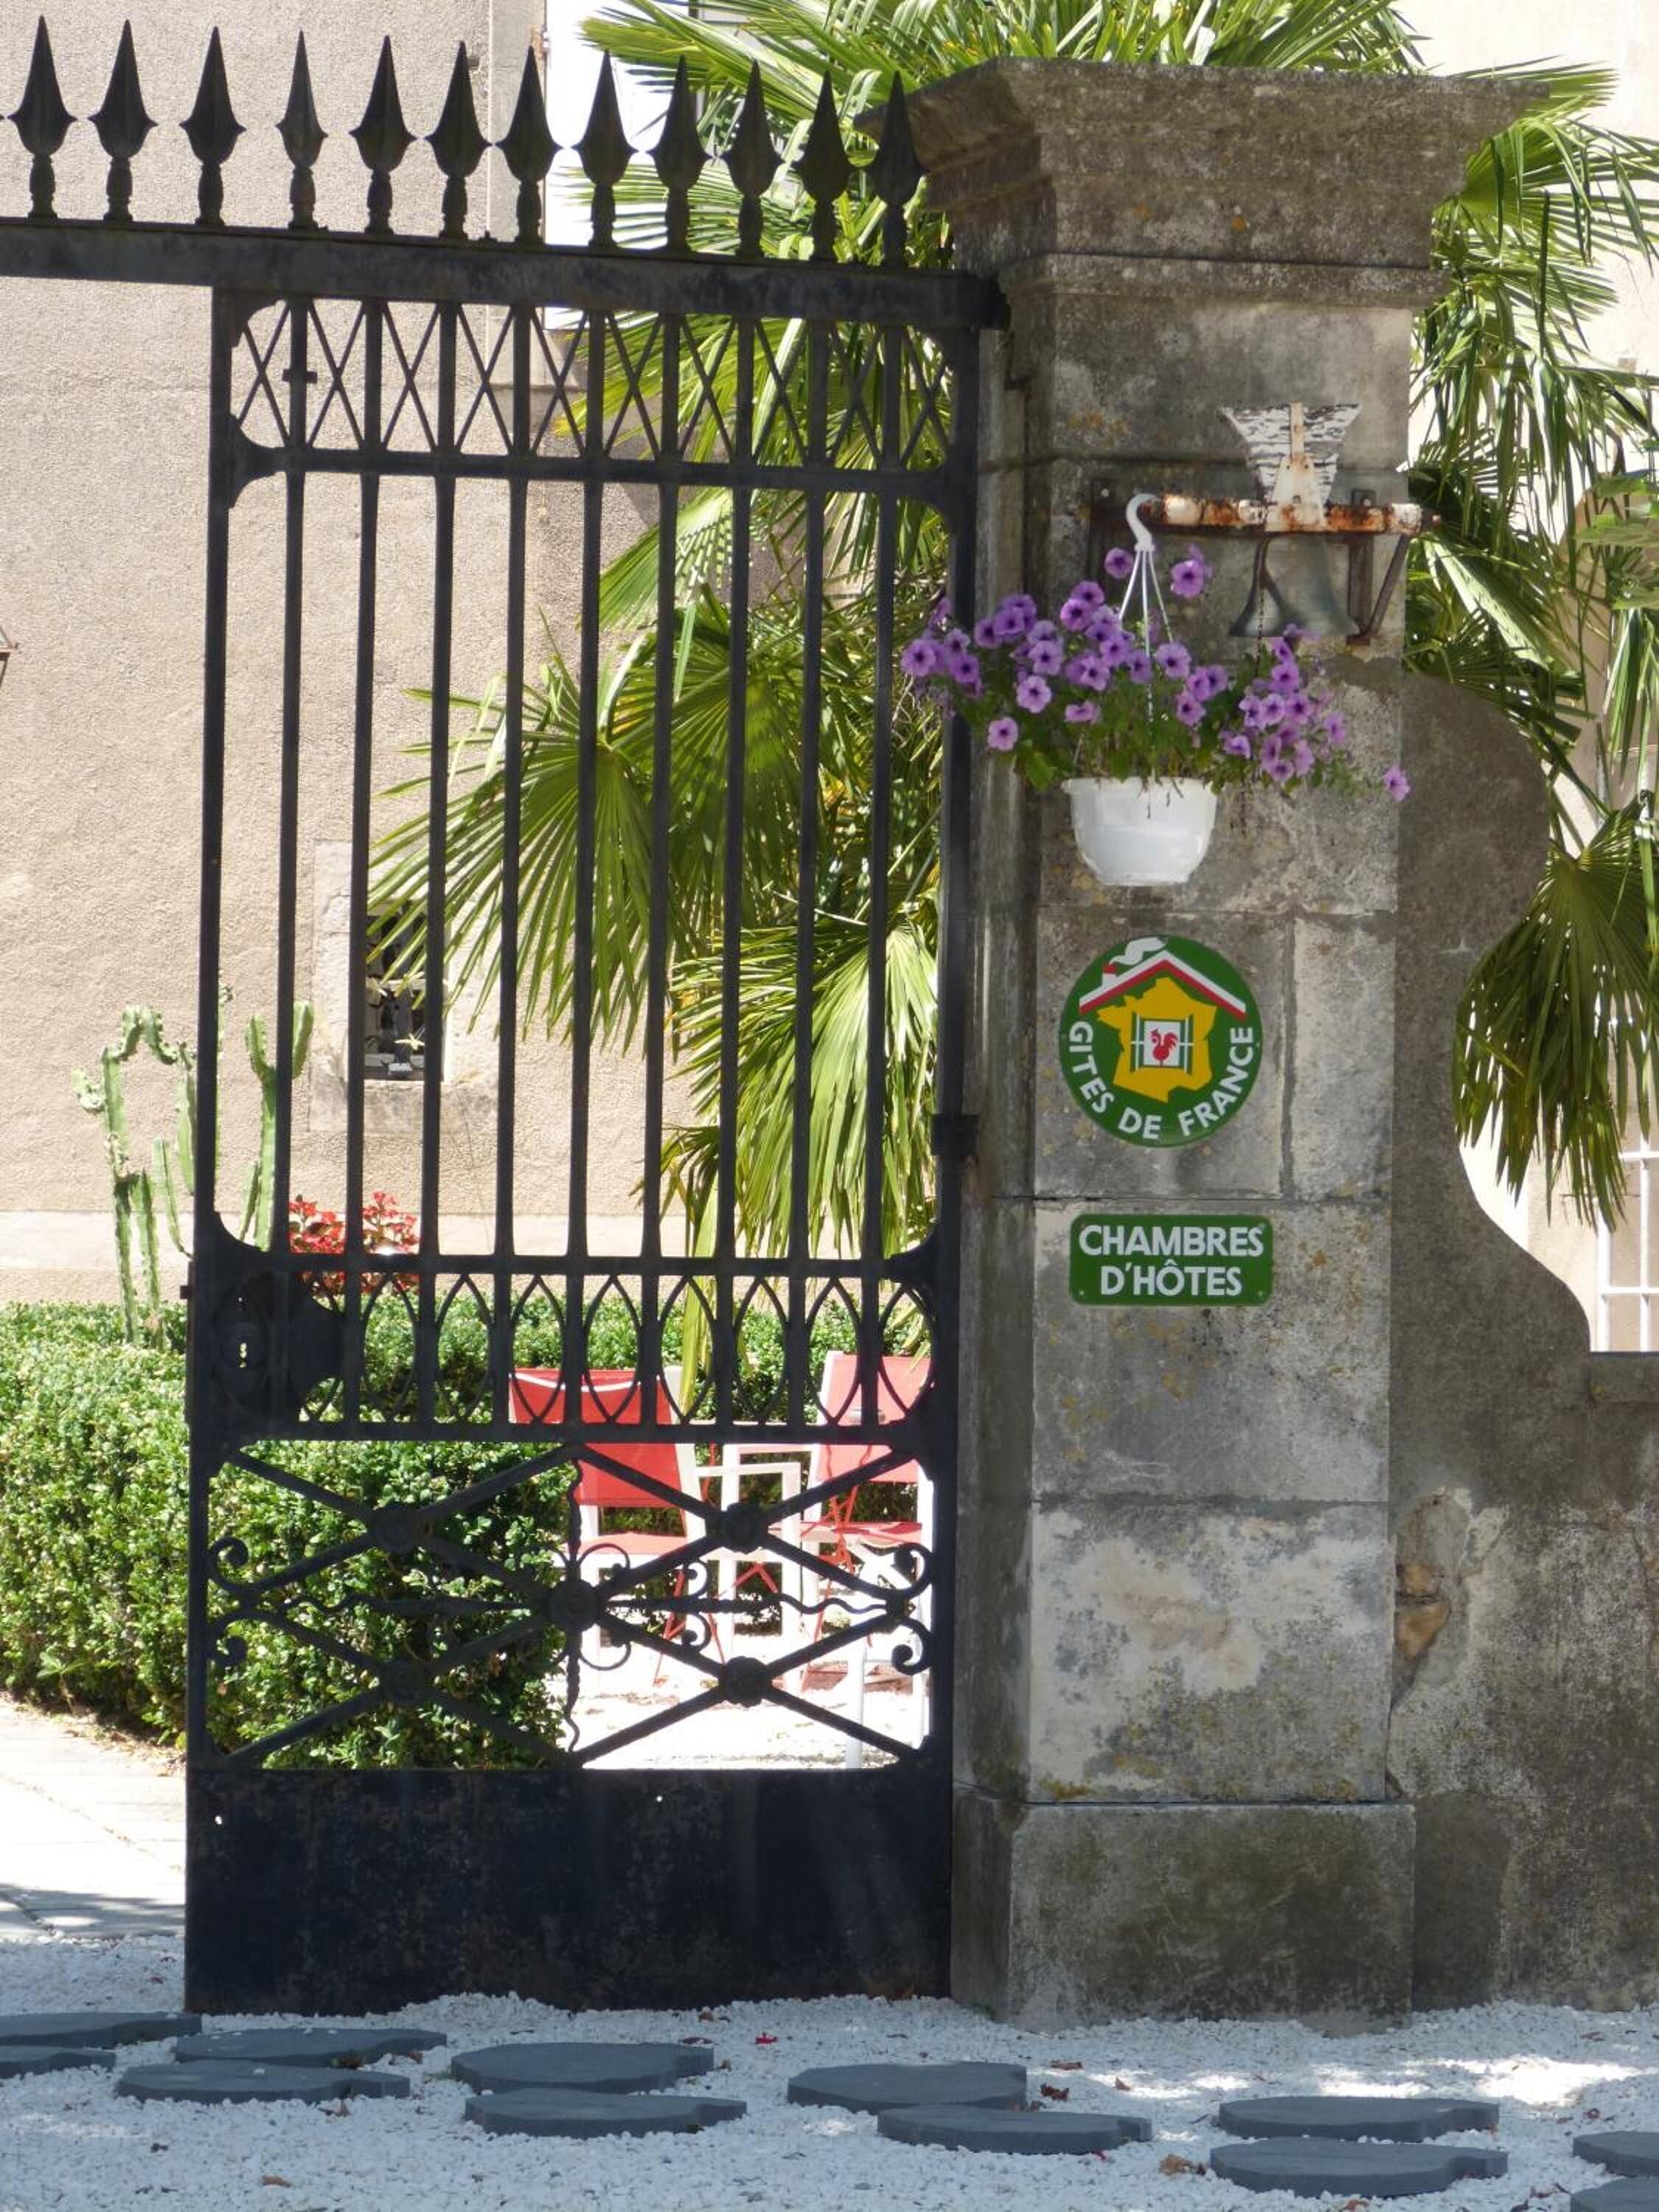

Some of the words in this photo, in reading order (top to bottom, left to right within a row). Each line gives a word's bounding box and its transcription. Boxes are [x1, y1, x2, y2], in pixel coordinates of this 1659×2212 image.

[1069, 1021, 1115, 1113] GITES
[1119, 1107, 1162, 1139] DE
[1178, 1027, 1253, 1136] FRANCE
[1079, 1225, 1264, 1256] CHAMBRES
[1101, 1259, 1242, 1296] D'HÔTES
